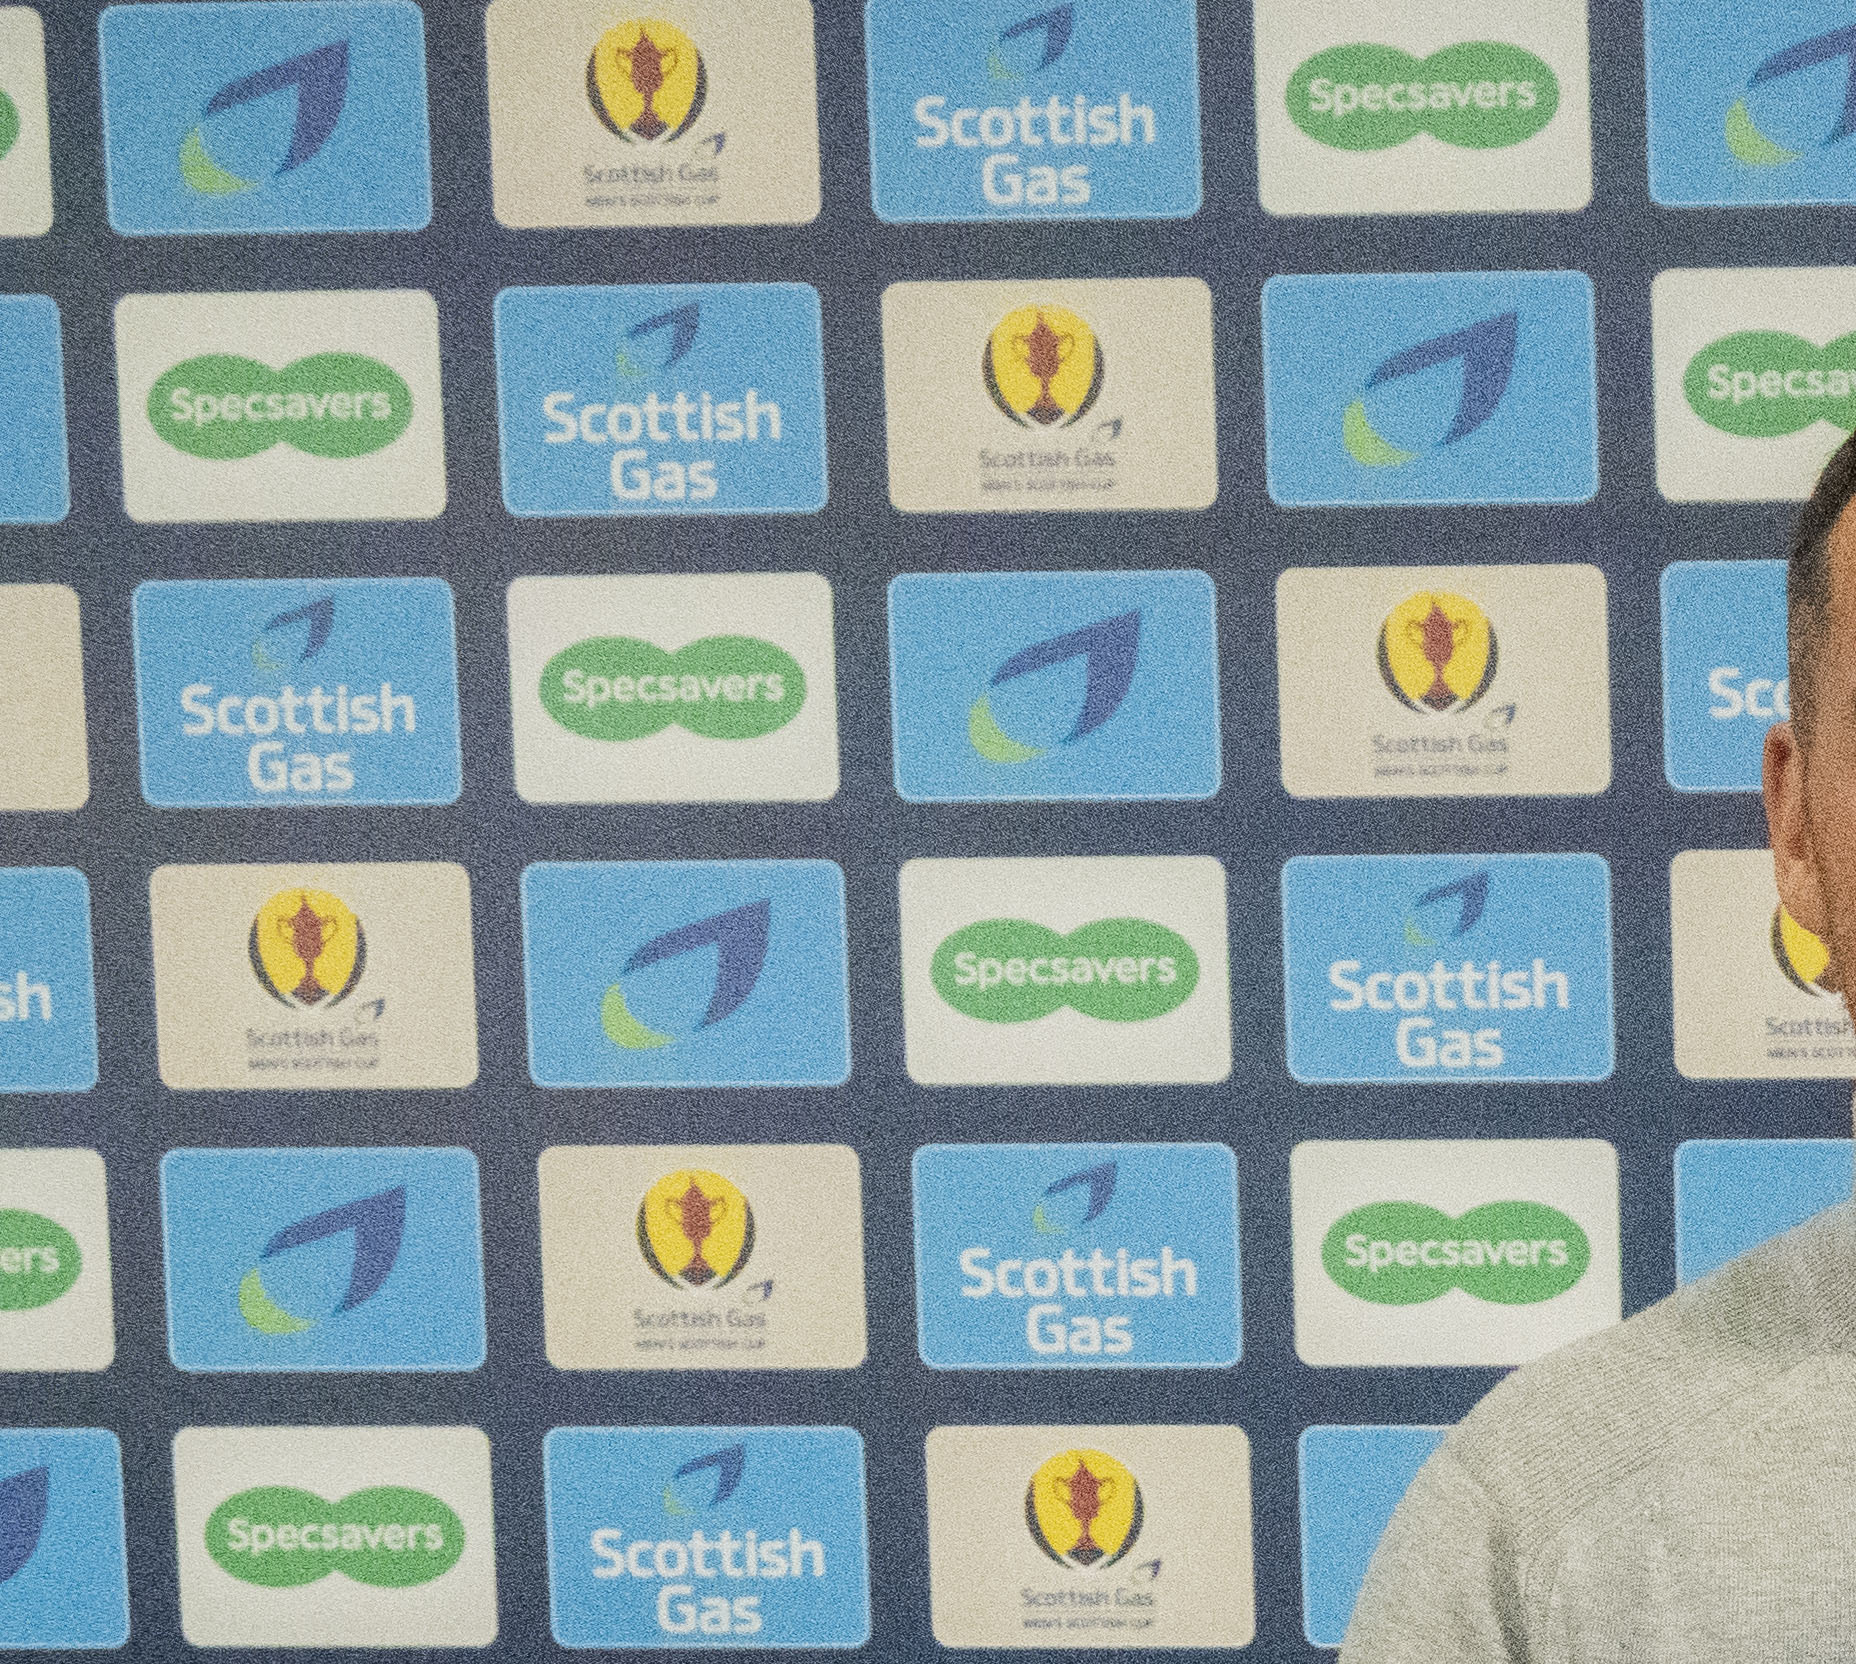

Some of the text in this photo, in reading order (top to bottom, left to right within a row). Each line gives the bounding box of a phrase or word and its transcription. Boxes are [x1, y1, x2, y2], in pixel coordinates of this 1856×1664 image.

[914, 93, 1156, 148] Scottish
[1308, 76, 1538, 119] Specsavers
[582, 166, 719, 184] Scottish Gas
[981, 153, 1091, 207] Gas
[169, 386, 392, 428] Specsavers
[542, 389, 782, 444] Scottish
[610, 448, 718, 501] Gas
[978, 450, 1116, 469] Scottish Gas
[181, 682, 416, 737] Scottish
[562, 668, 786, 710] Specsavers
[247, 740, 355, 794] Gas
[1372, 736, 1510, 755] Scottish Gas
[953, 950, 1178, 991] Specsavers
[1329, 959, 1569, 1011] Scottish
[245, 1030, 379, 1048] Scottish Gas
[1395, 1016, 1504, 1069] Gas
[959, 1246, 1197, 1298] Scottish
[1344, 1232, 1569, 1274] Specsavers
[633, 1310, 766, 1329] Scottish Gas
[1026, 1303, 1133, 1355] Gas
[226, 1516, 445, 1557] Specsavers
[590, 1527, 825, 1579] Scottish
[657, 1583, 762, 1635] Gas
[1020, 1590, 1156, 1608] Scottish Gas
